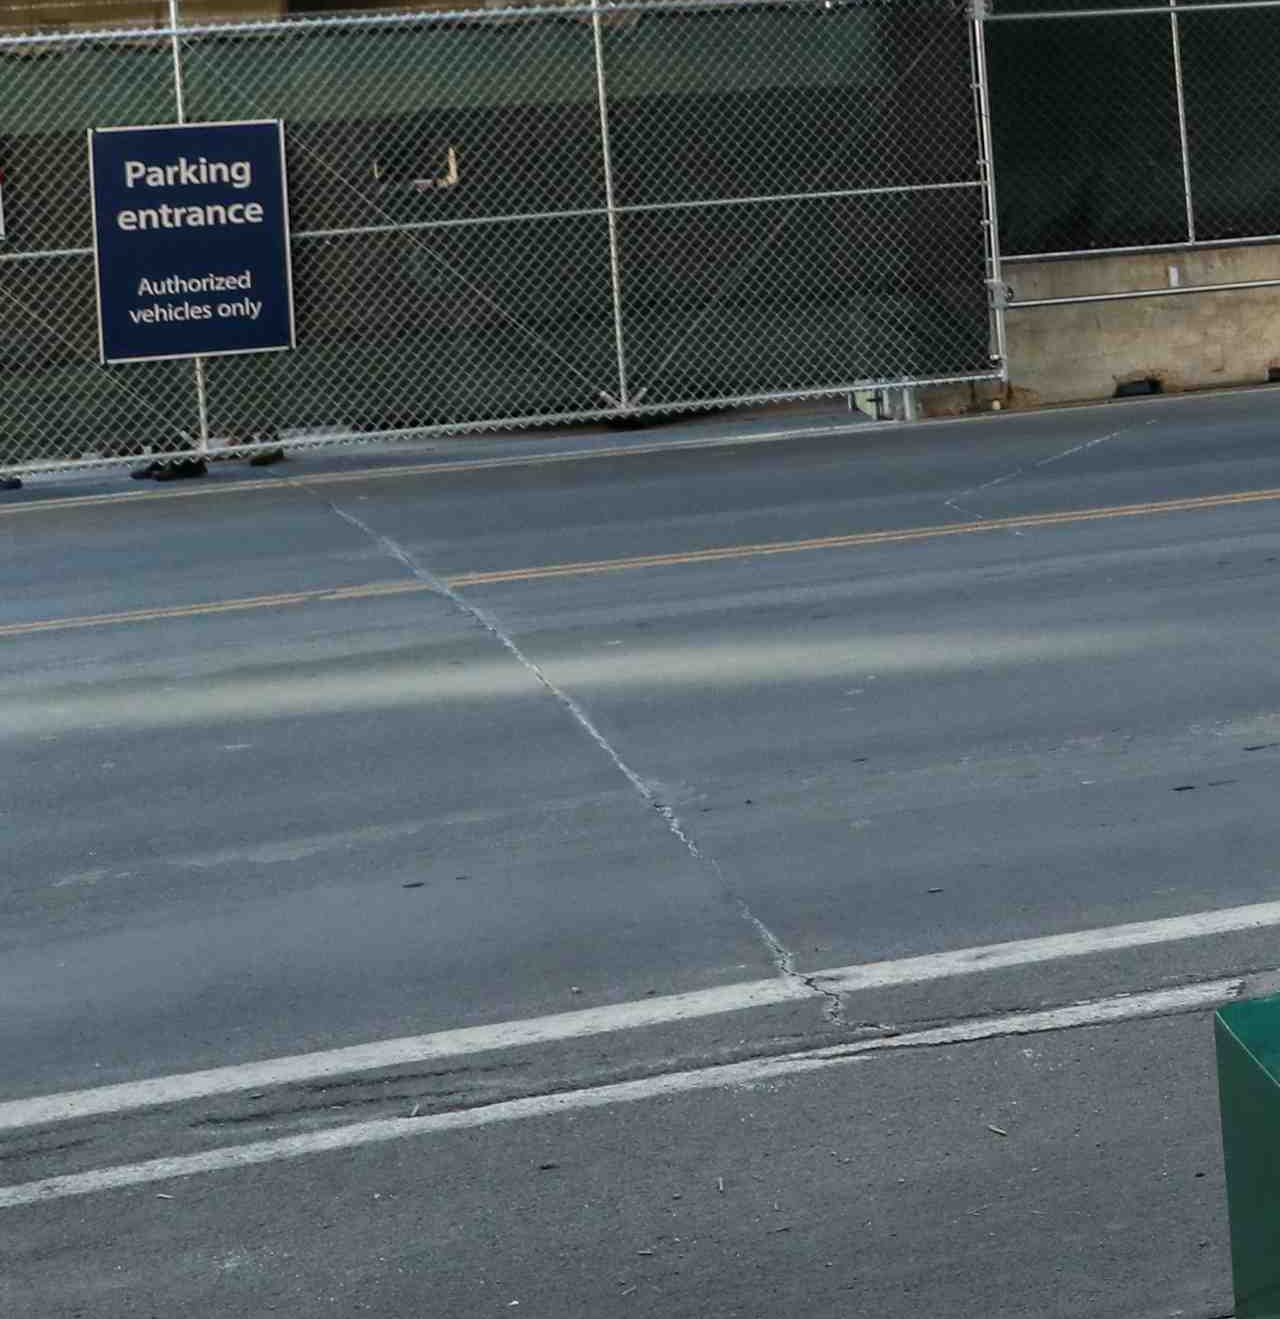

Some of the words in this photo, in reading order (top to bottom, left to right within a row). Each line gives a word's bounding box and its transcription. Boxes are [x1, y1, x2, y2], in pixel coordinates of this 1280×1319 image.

[123, 157, 252, 189] Parking
[116, 201, 265, 231] entrance
[136, 269, 252, 297] Authorized
[128, 300, 213, 325] vehicles
[216, 296, 263, 321] only
